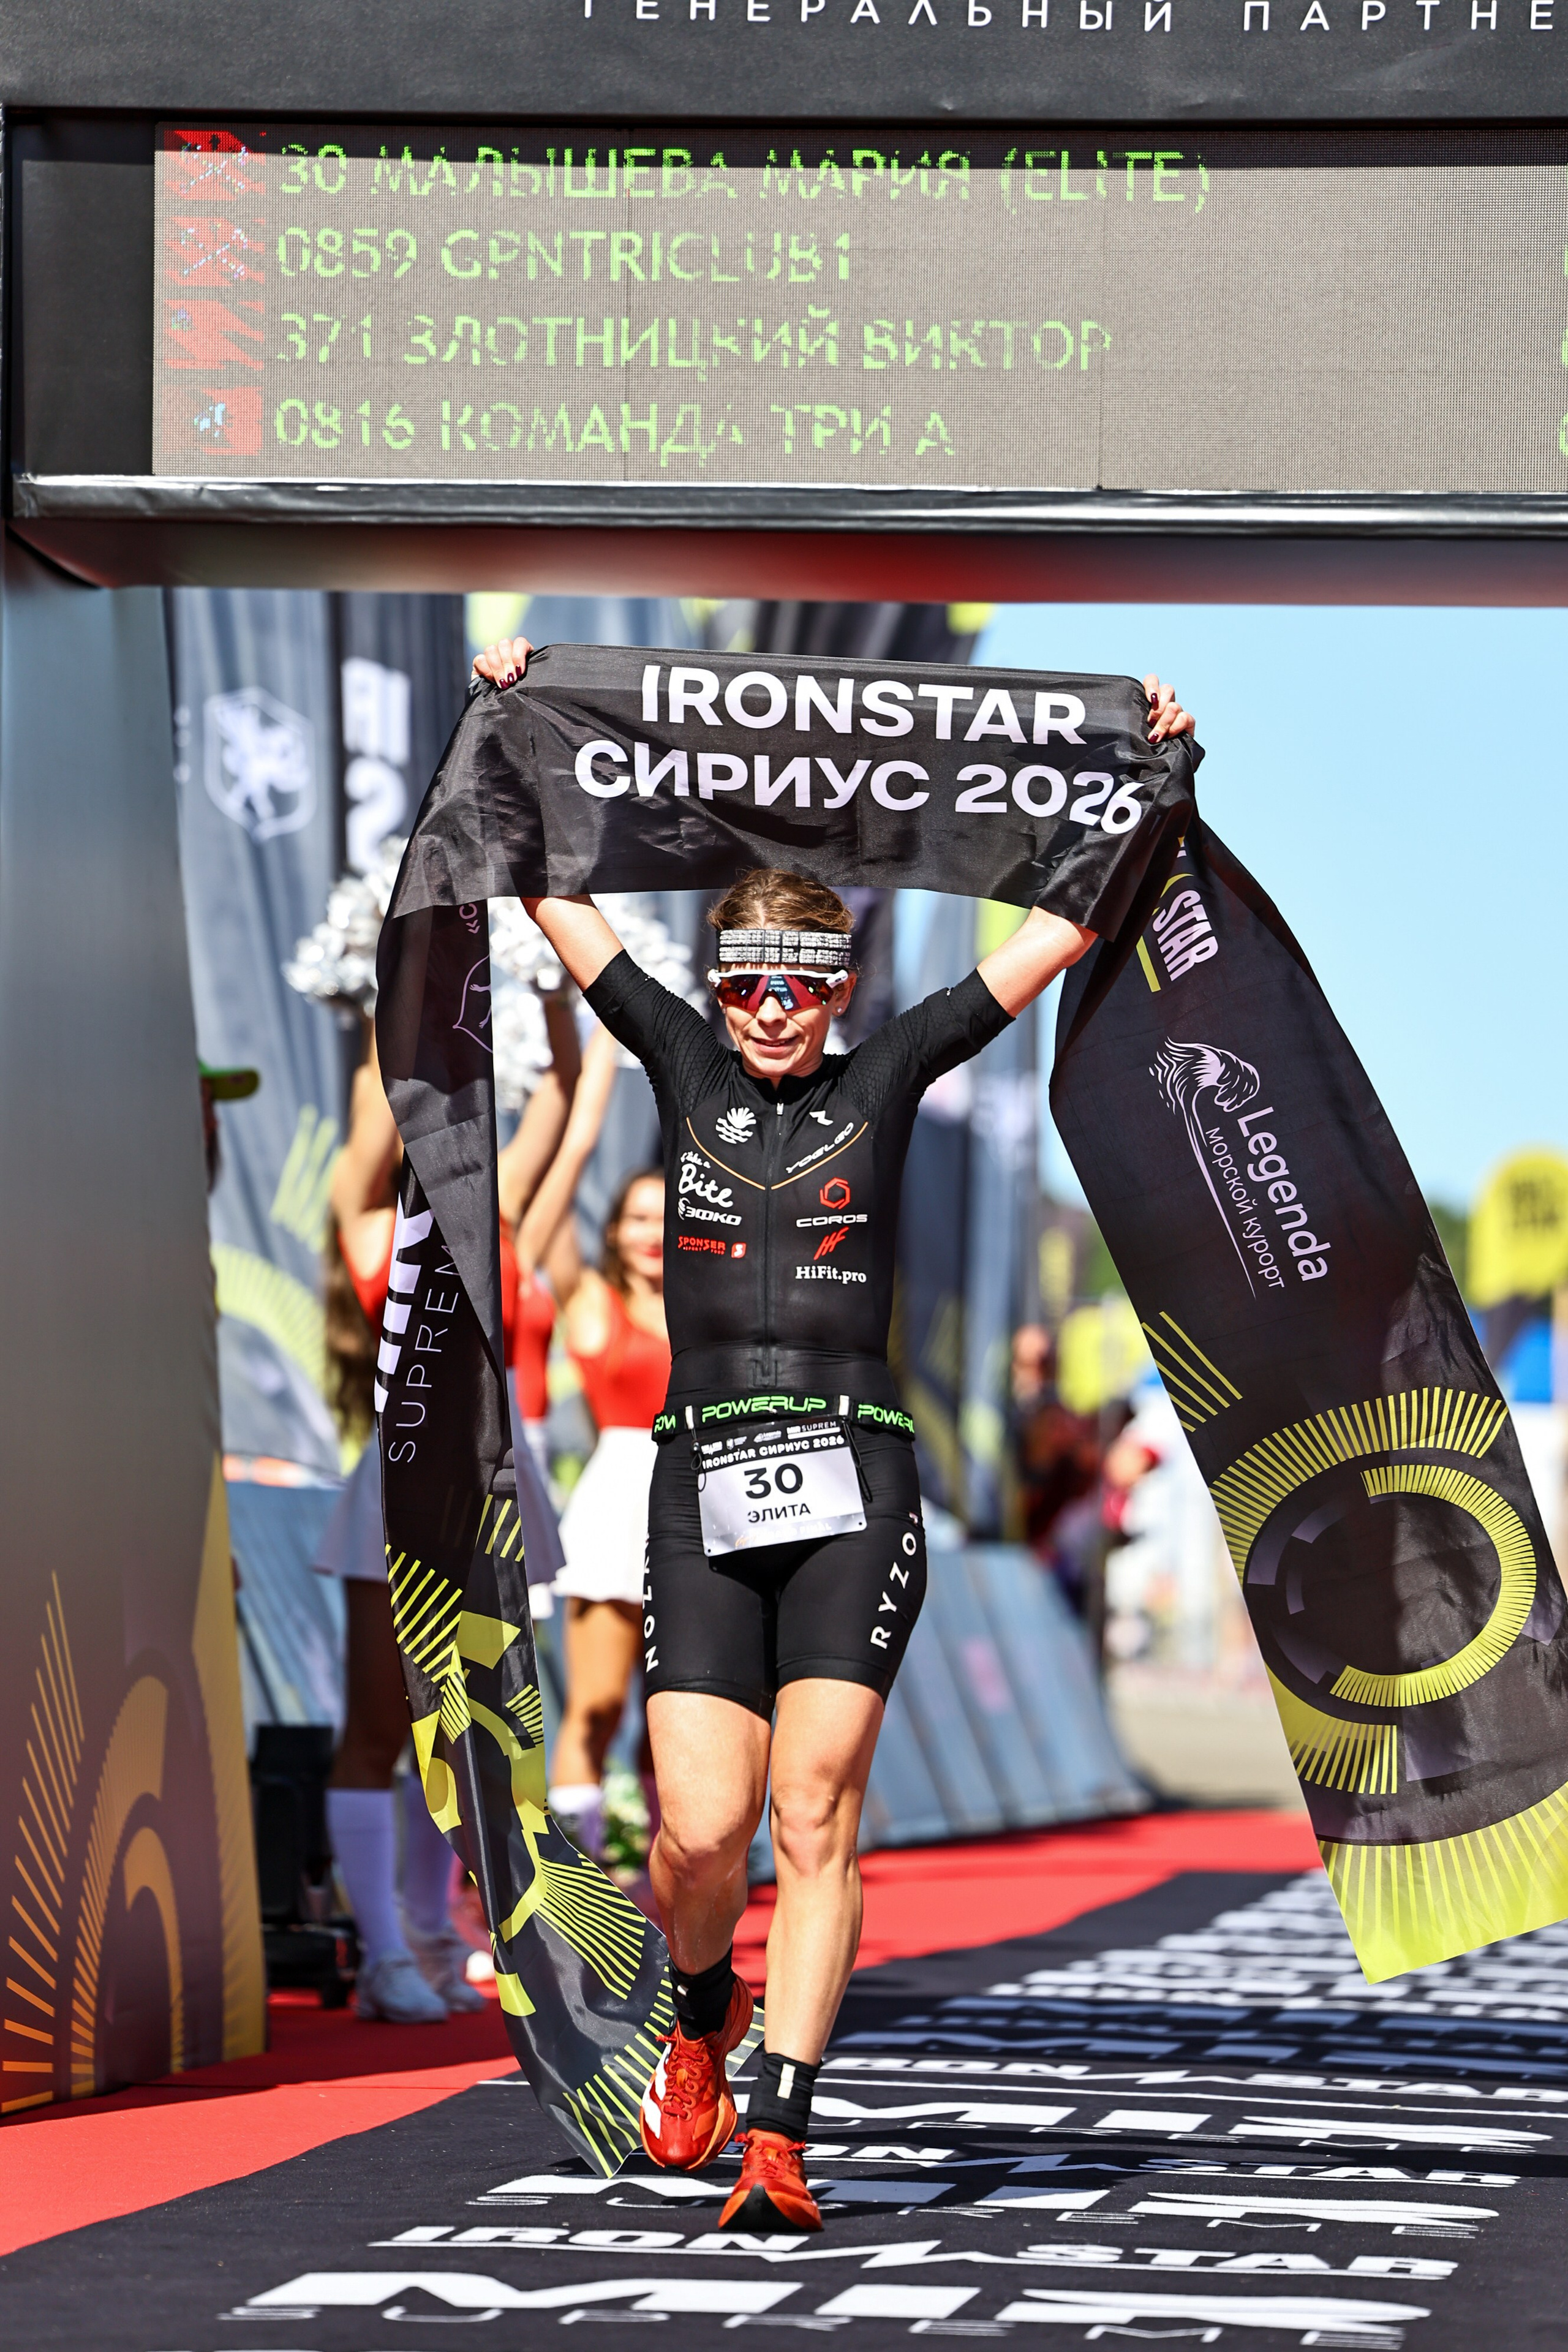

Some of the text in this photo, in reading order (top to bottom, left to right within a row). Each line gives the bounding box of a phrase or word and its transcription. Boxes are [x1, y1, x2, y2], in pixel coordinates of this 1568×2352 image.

[1243, 0, 1555, 31] ПАРТНЕ
[281, 144, 347, 194] 30
[371, 145, 737, 199] МАЛЫШЕВА
[277, 227, 418, 279] 0859
[278, 304, 1112, 382] 371 ЗЛОТНИЦКИЙ ВИКТОР
[274, 398, 415, 450] 0816
[641, 665, 1087, 746] IRONSTAR
[575, 740, 1144, 835] СИРИУС 2026
[1152, 890, 1219, 981] STAR
[678, 1163, 733, 1208] Bite
[1237, 1107, 1329, 1282] Legenda
[677, 1236, 726, 1251] SPONSER
[796, 1214, 868, 1227] COROS
[796, 1265, 867, 1284] HiFit.pro
[1243, 1215, 1285, 1289] курорт
[702, 1395, 827, 1423] POWERUP
[702, 1449, 756, 1469] IRONSTAR
[759, 1439, 810, 1457] СИРИУС
[813, 1434, 845, 1449] 2026
[744, 1463, 804, 1499] 30
[747, 1502, 811, 1524] ЭЛИТА
[1139, 2158, 1521, 2185] STAR
[393, 2226, 1459, 2276] IRON STAR
